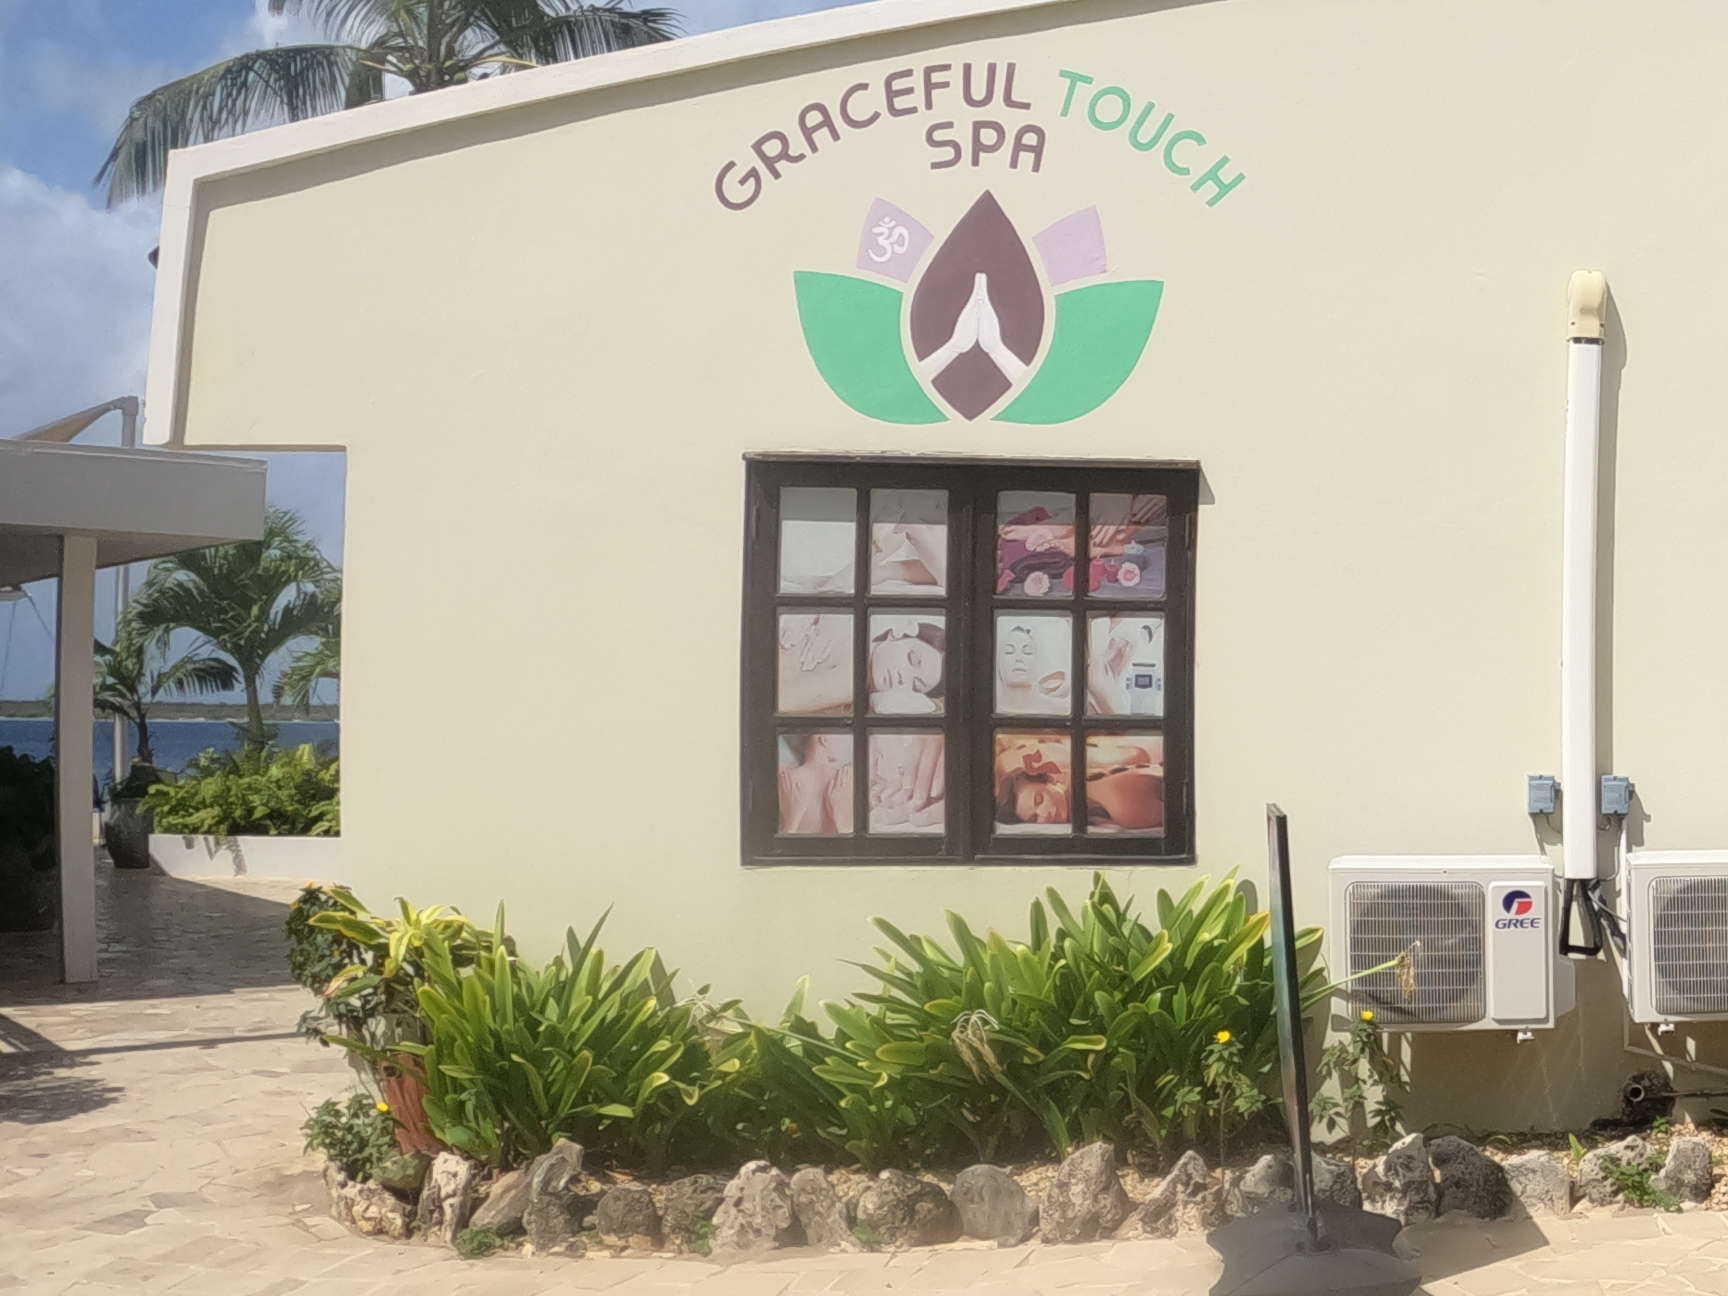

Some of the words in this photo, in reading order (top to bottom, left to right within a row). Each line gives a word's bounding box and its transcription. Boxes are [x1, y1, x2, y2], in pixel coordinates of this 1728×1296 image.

[715, 62, 1032, 211] GRACEFUL
[1058, 69, 1246, 208] TOUCH
[925, 120, 1046, 173] SPA
[1495, 917, 1542, 929] GREE
